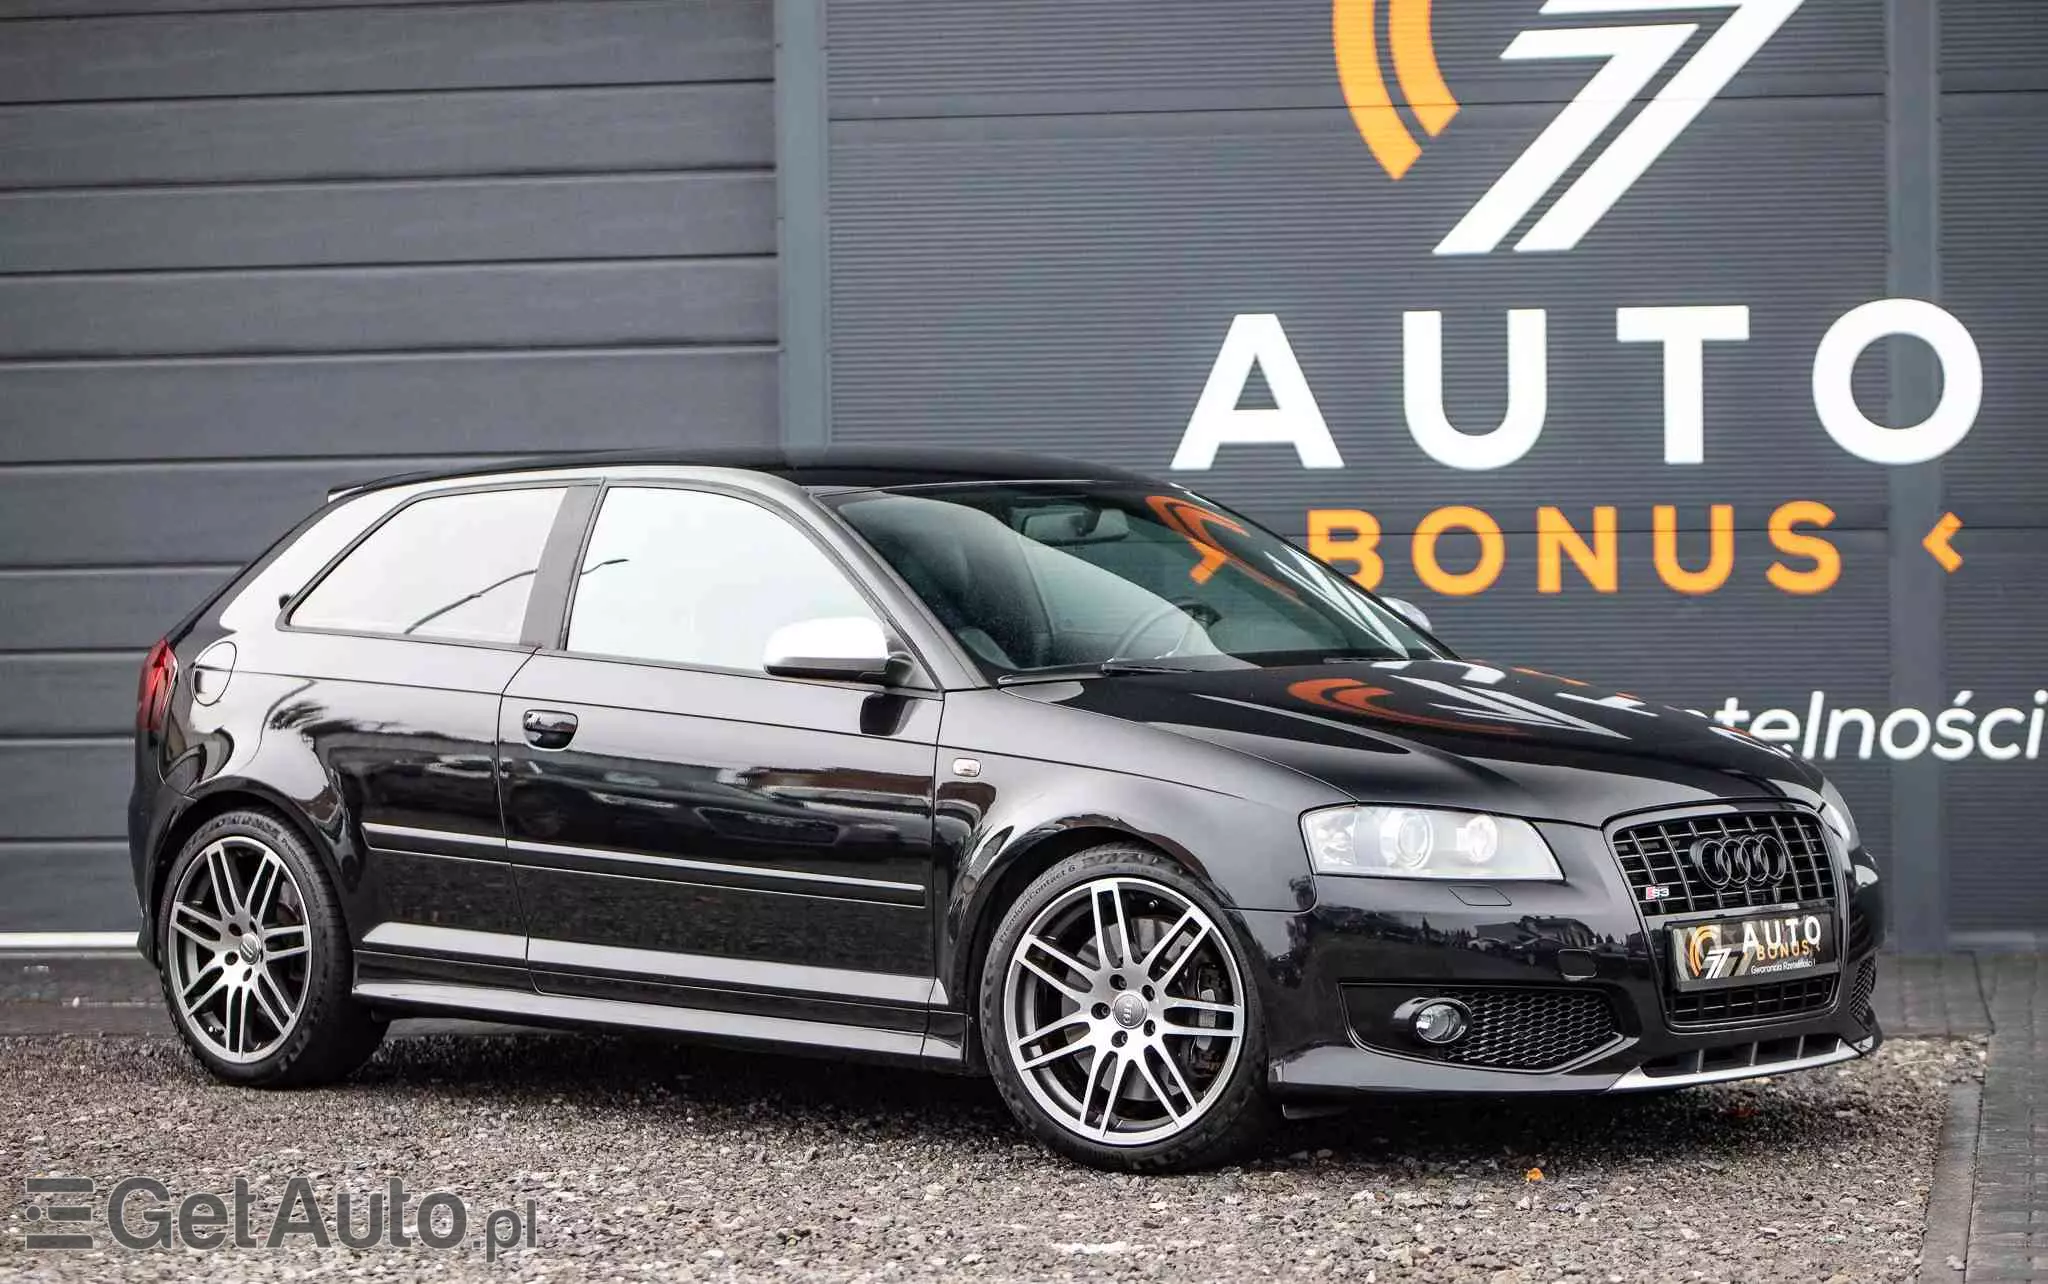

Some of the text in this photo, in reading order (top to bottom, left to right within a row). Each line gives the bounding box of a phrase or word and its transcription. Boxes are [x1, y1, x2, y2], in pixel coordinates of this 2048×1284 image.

[1170, 298, 1983, 471] AUTO
[1308, 502, 1842, 594] BONUS
[1685, 690, 2048, 760] telności
[1742, 915, 1822, 951] AUTO
[1756, 939, 1810, 961] BONUS
